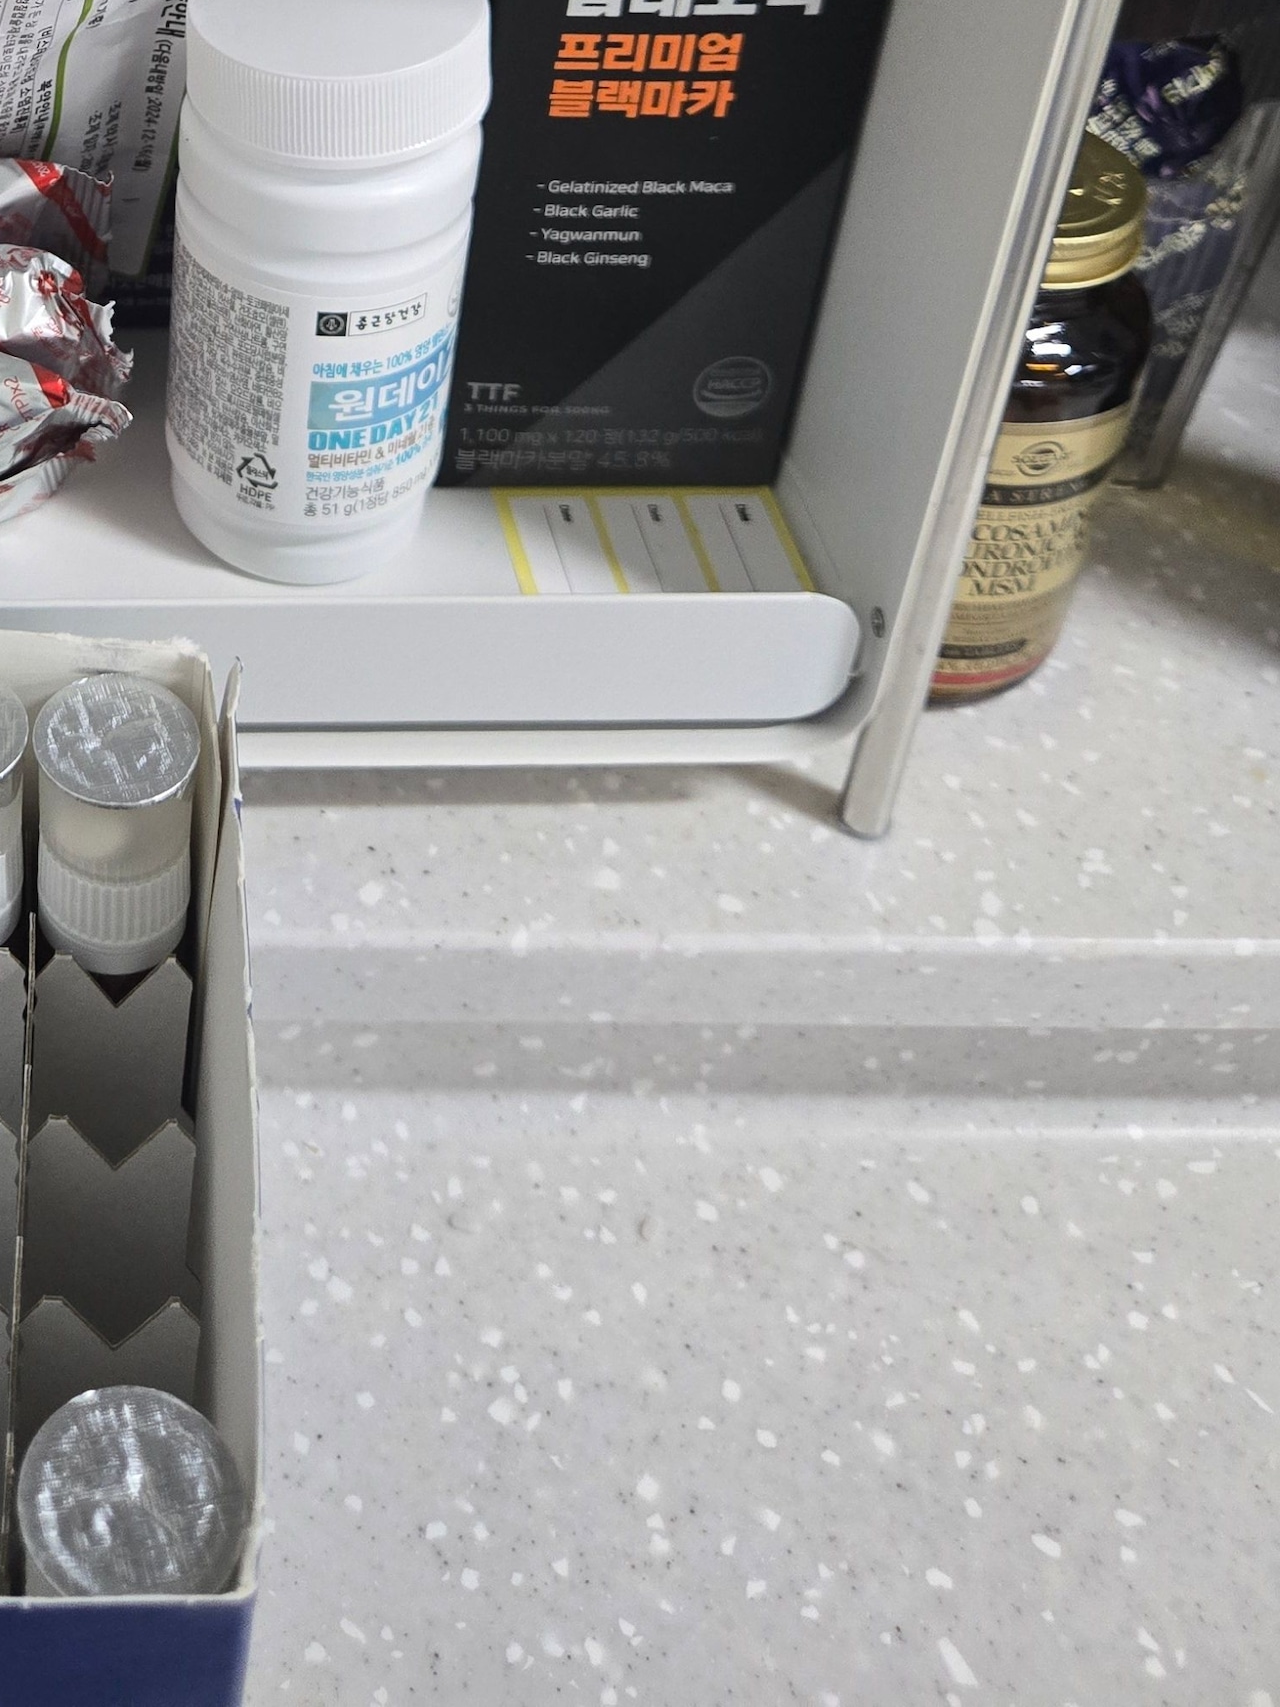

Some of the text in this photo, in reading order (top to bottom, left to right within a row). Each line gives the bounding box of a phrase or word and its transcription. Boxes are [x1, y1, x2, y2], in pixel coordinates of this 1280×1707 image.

[553, 32, 743, 72] 프리미엄
[549, 79, 734, 118] 블랙마카
[548, 179, 733, 194] Gelatinized Black Maca
[545, 204, 639, 218] Black Garlic
[541, 228, 641, 244] Yagwanmun
[537, 251, 649, 268] Black Ginseng
[312, 350, 412, 379] 아침에 채우는 100%
[467, 381, 521, 402] TTF
[475, 404, 528, 414] THINGS
[309, 426, 366, 451] ONE
[370, 409, 418, 445] DAY
[566, 428, 597, 444] 120
[307, 430, 417, 469] 멀티비타민 & 미네랄
[395, 444, 420, 466] 100%
[239, 483, 273, 504] HDPE
[305, 477, 386, 501] 건강기능식품
[304, 502, 317, 517] 총
[322, 503, 338, 515] 51
